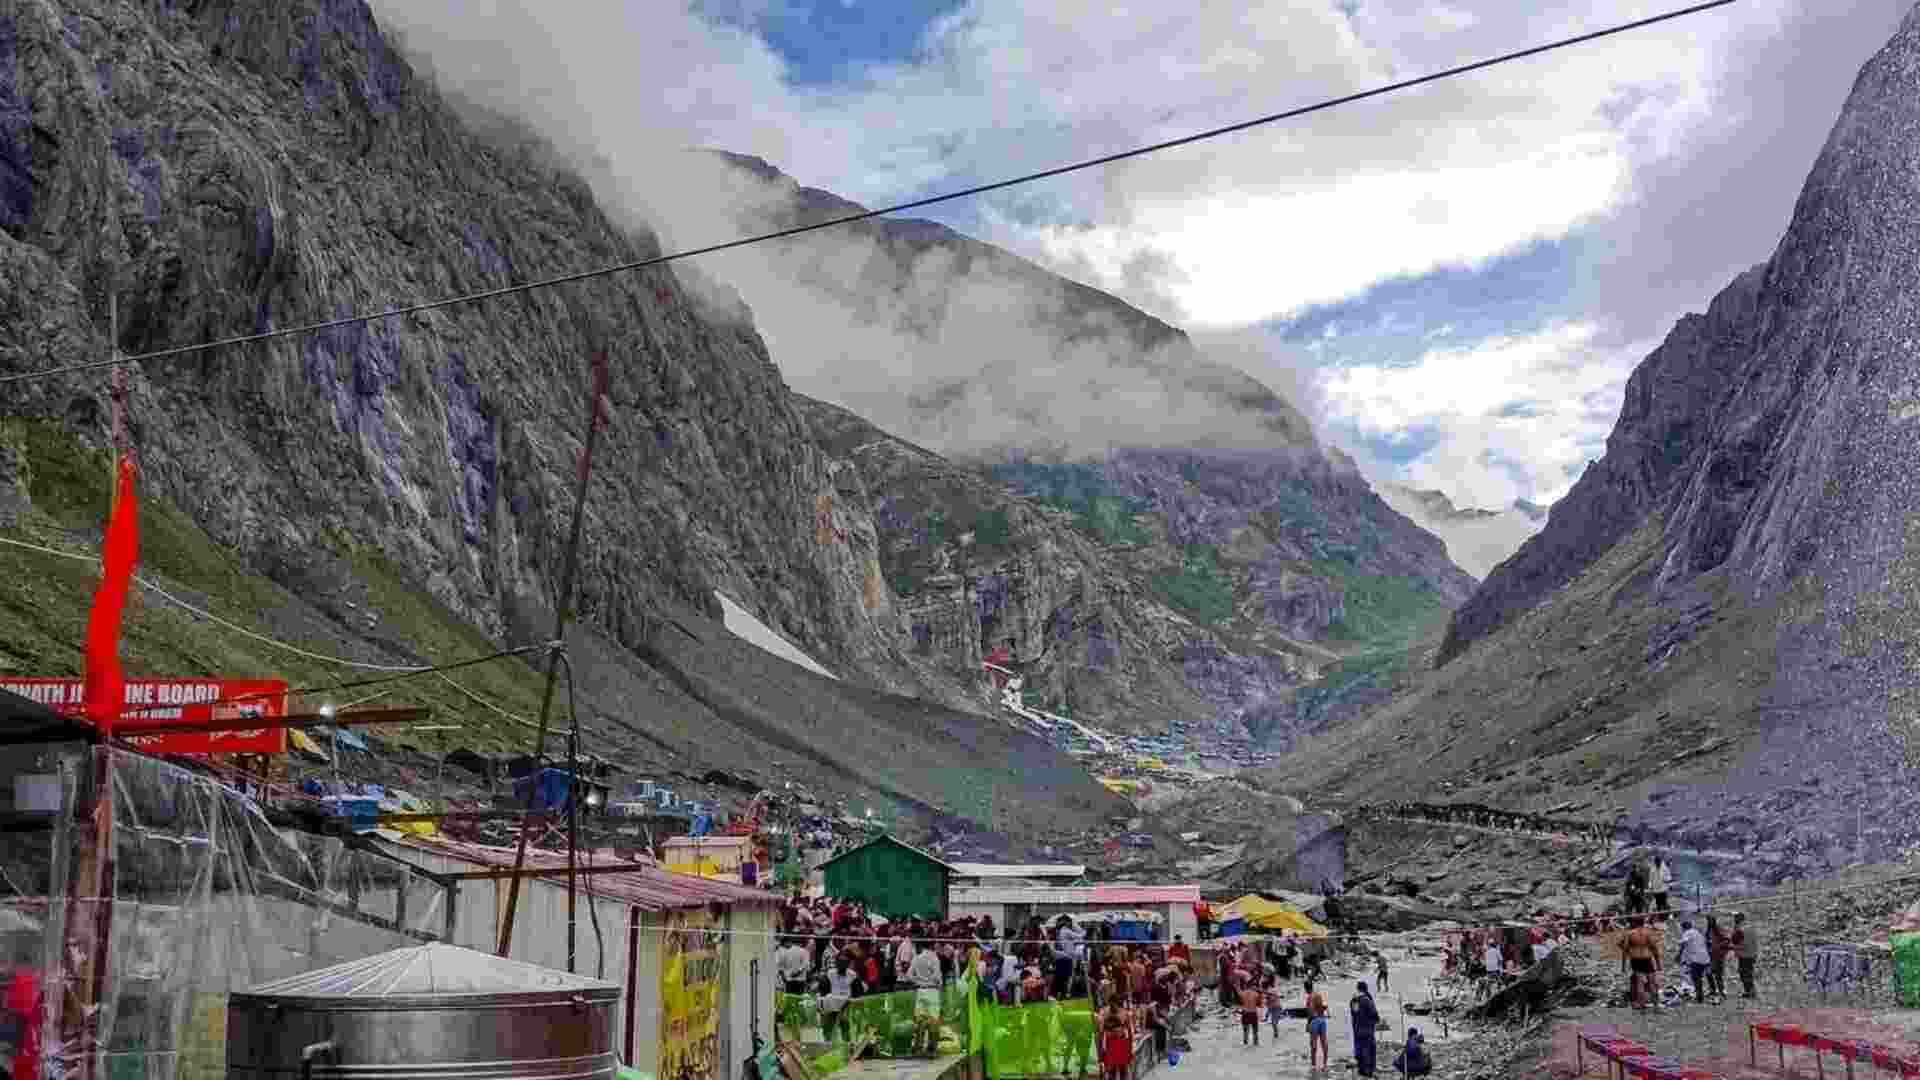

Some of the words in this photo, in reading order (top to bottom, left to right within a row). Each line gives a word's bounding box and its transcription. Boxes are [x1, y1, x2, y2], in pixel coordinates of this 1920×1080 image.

[0, 683, 64, 704] NATH
[124, 683, 155, 704] INE
[158, 683, 220, 705] BOARD
